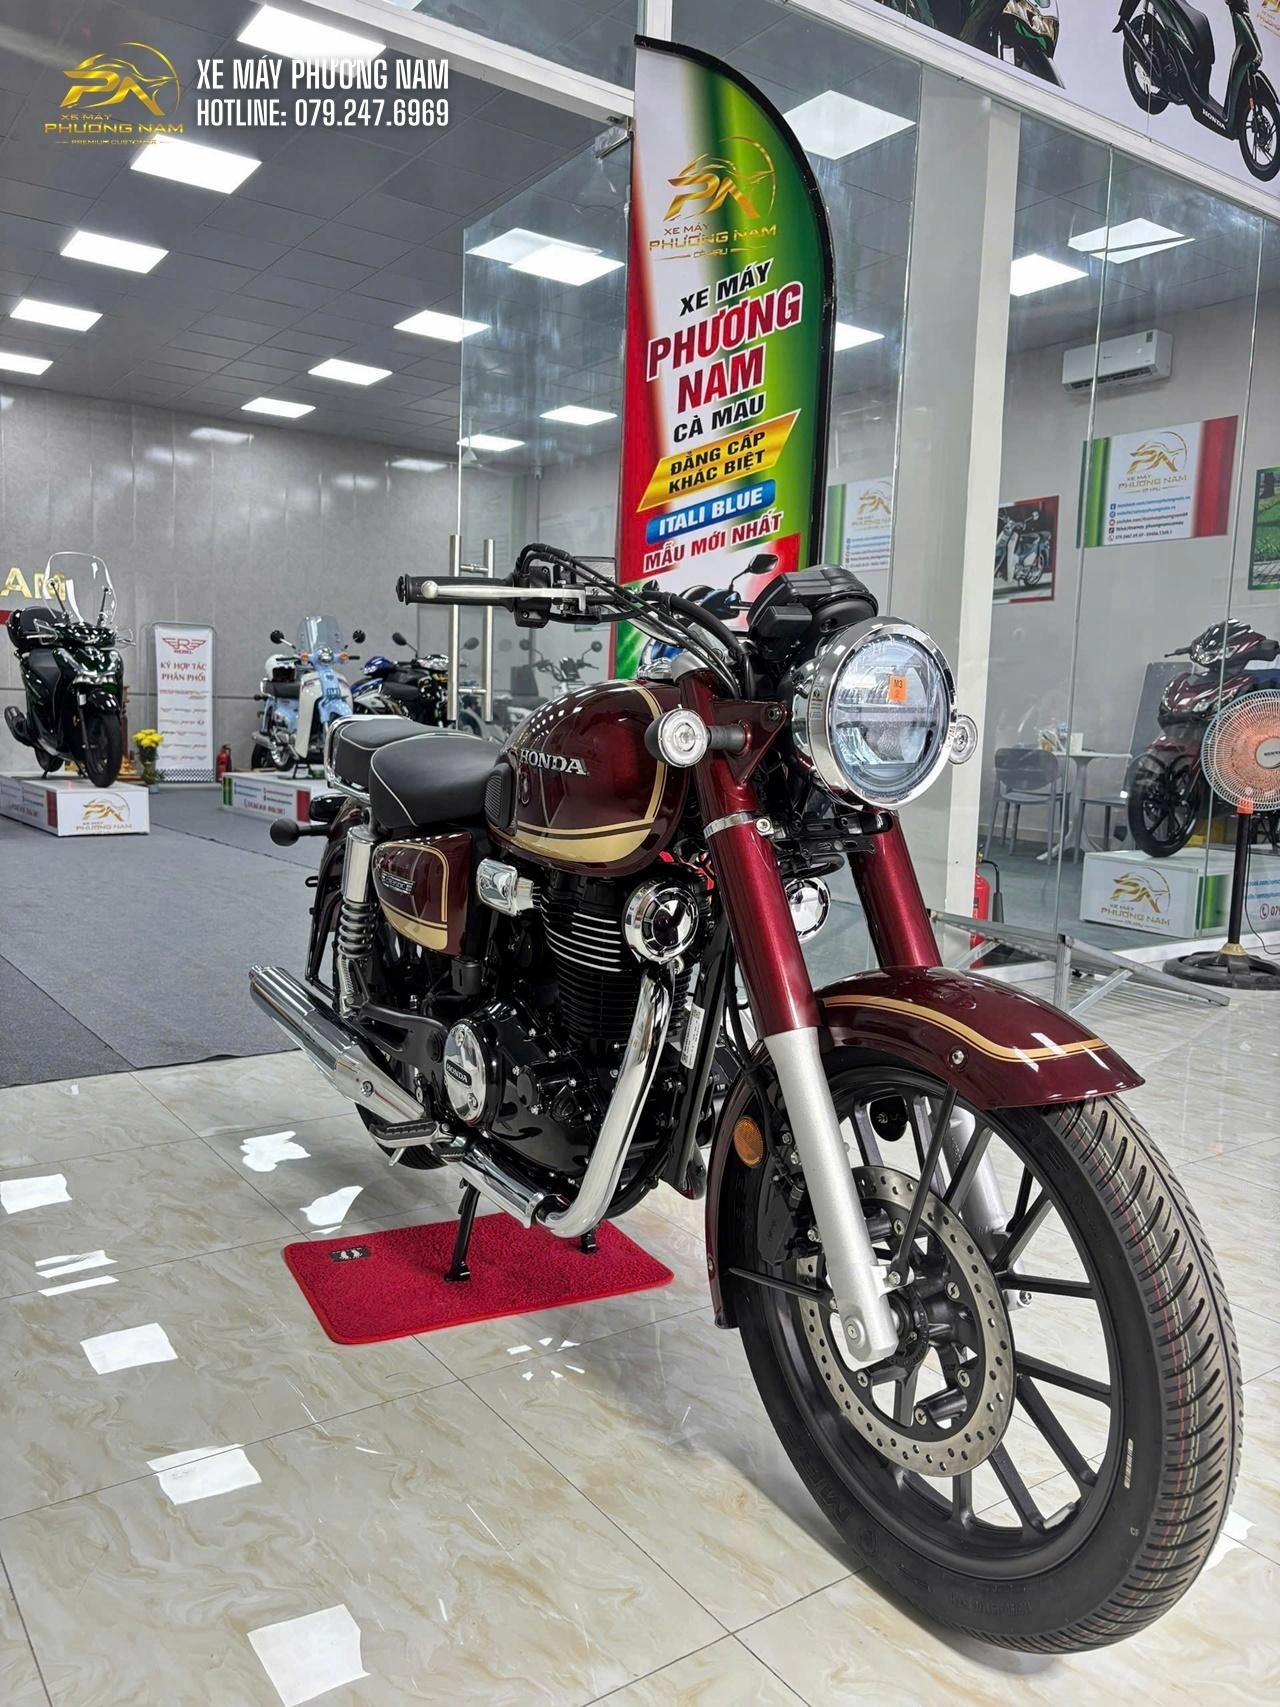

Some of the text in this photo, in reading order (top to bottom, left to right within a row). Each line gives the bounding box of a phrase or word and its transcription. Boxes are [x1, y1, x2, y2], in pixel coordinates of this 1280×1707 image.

[1202, 108, 1226, 130] HONDA
[664, 223, 711, 236] XE MÁY
[733, 224, 778, 241] NAM
[680, 260, 772, 317] XE MÁY
[648, 282, 802, 380] PHƯƠNG
[677, 345, 765, 415] NAM
[673, 394, 765, 443] CÀ MAU
[727, 430, 766, 456] CẤP
[668, 449, 766, 494] KHÁC BIỆT
[658, 486, 763, 536] ITALI BLUE
[644, 509, 782, 572] MẪU MỚI NHẤT
[520, 749, 587, 776] HONDA
[446, 1063, 468, 1083] HONDA
